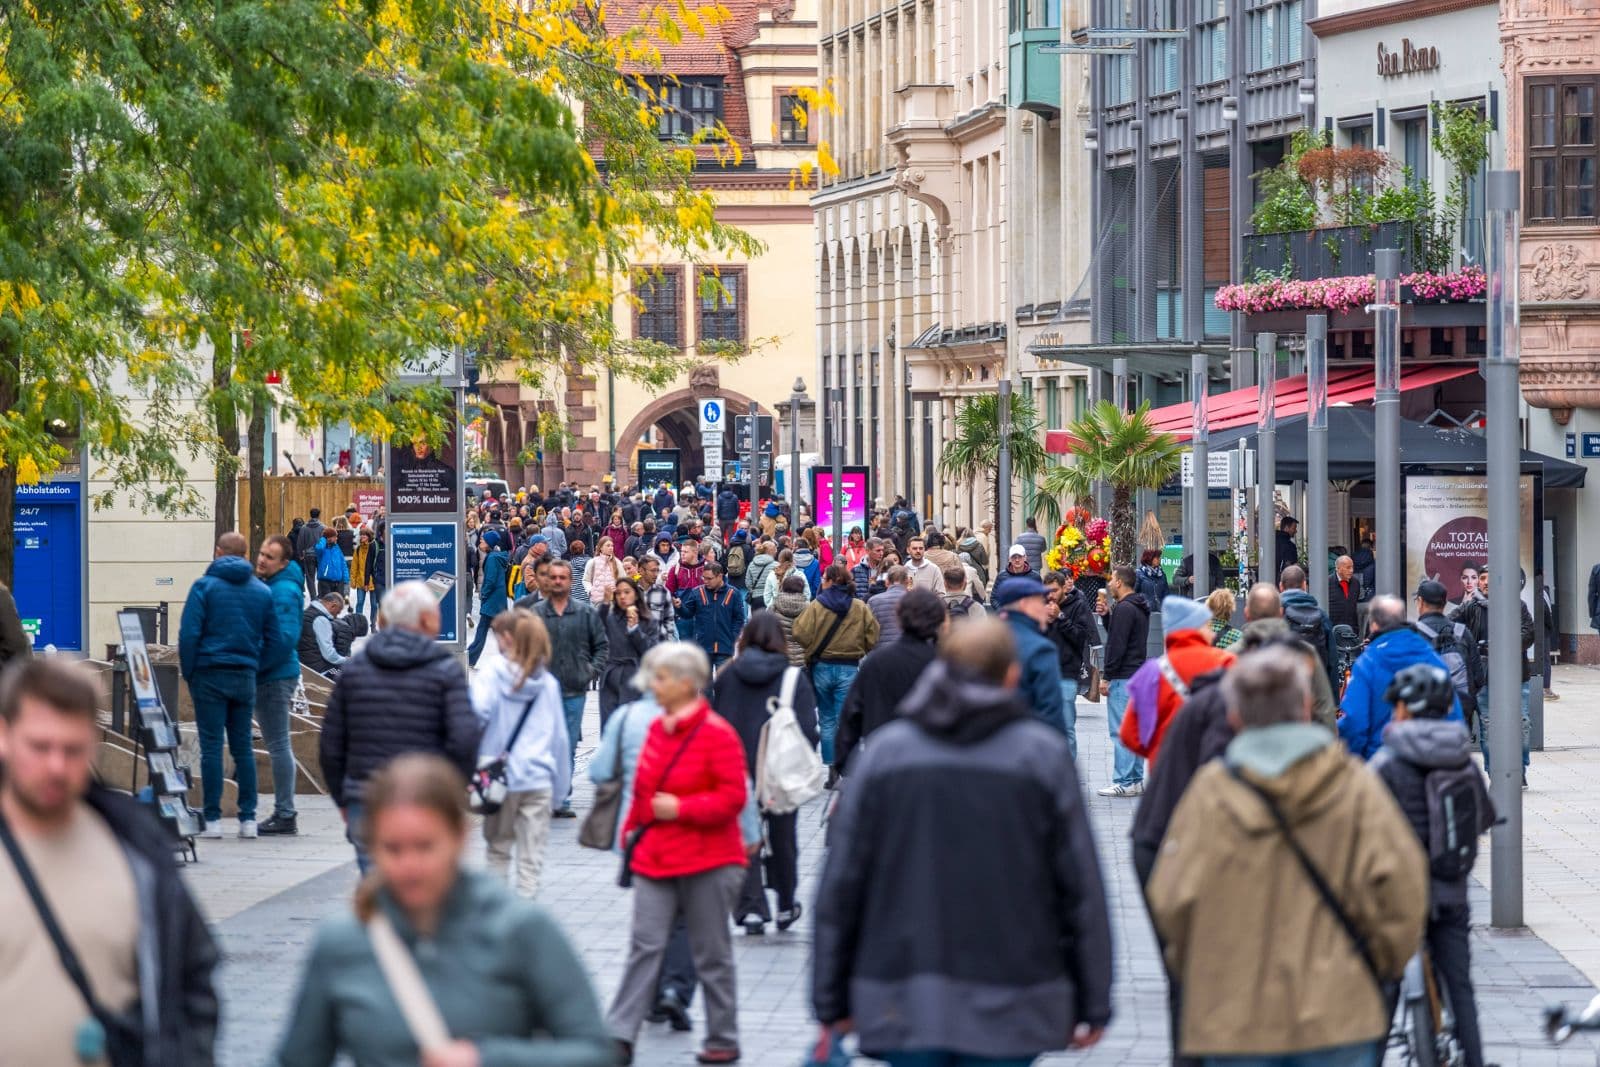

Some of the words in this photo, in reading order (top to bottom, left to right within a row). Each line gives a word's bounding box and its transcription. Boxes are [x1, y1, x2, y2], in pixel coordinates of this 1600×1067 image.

[1377, 41, 1399, 76] San
[1401, 38, 1439, 73] Remo
[16, 486, 71, 494] Abholstation
[397, 495, 421, 504] 100%
[422, 494, 451, 504] Kultur
[20, 507, 40, 516] 24/7
[1448, 532, 1488, 542] TOTAL
[395, 542, 425, 550] Wohnung
[425, 542, 452, 550] gesucht?
[1430, 541, 1488, 550] RÄUMUNGSVER
[396, 550, 409, 558] App
[395, 557, 425, 565] Wohnung
[1160, 556, 1171, 566] FÜR
